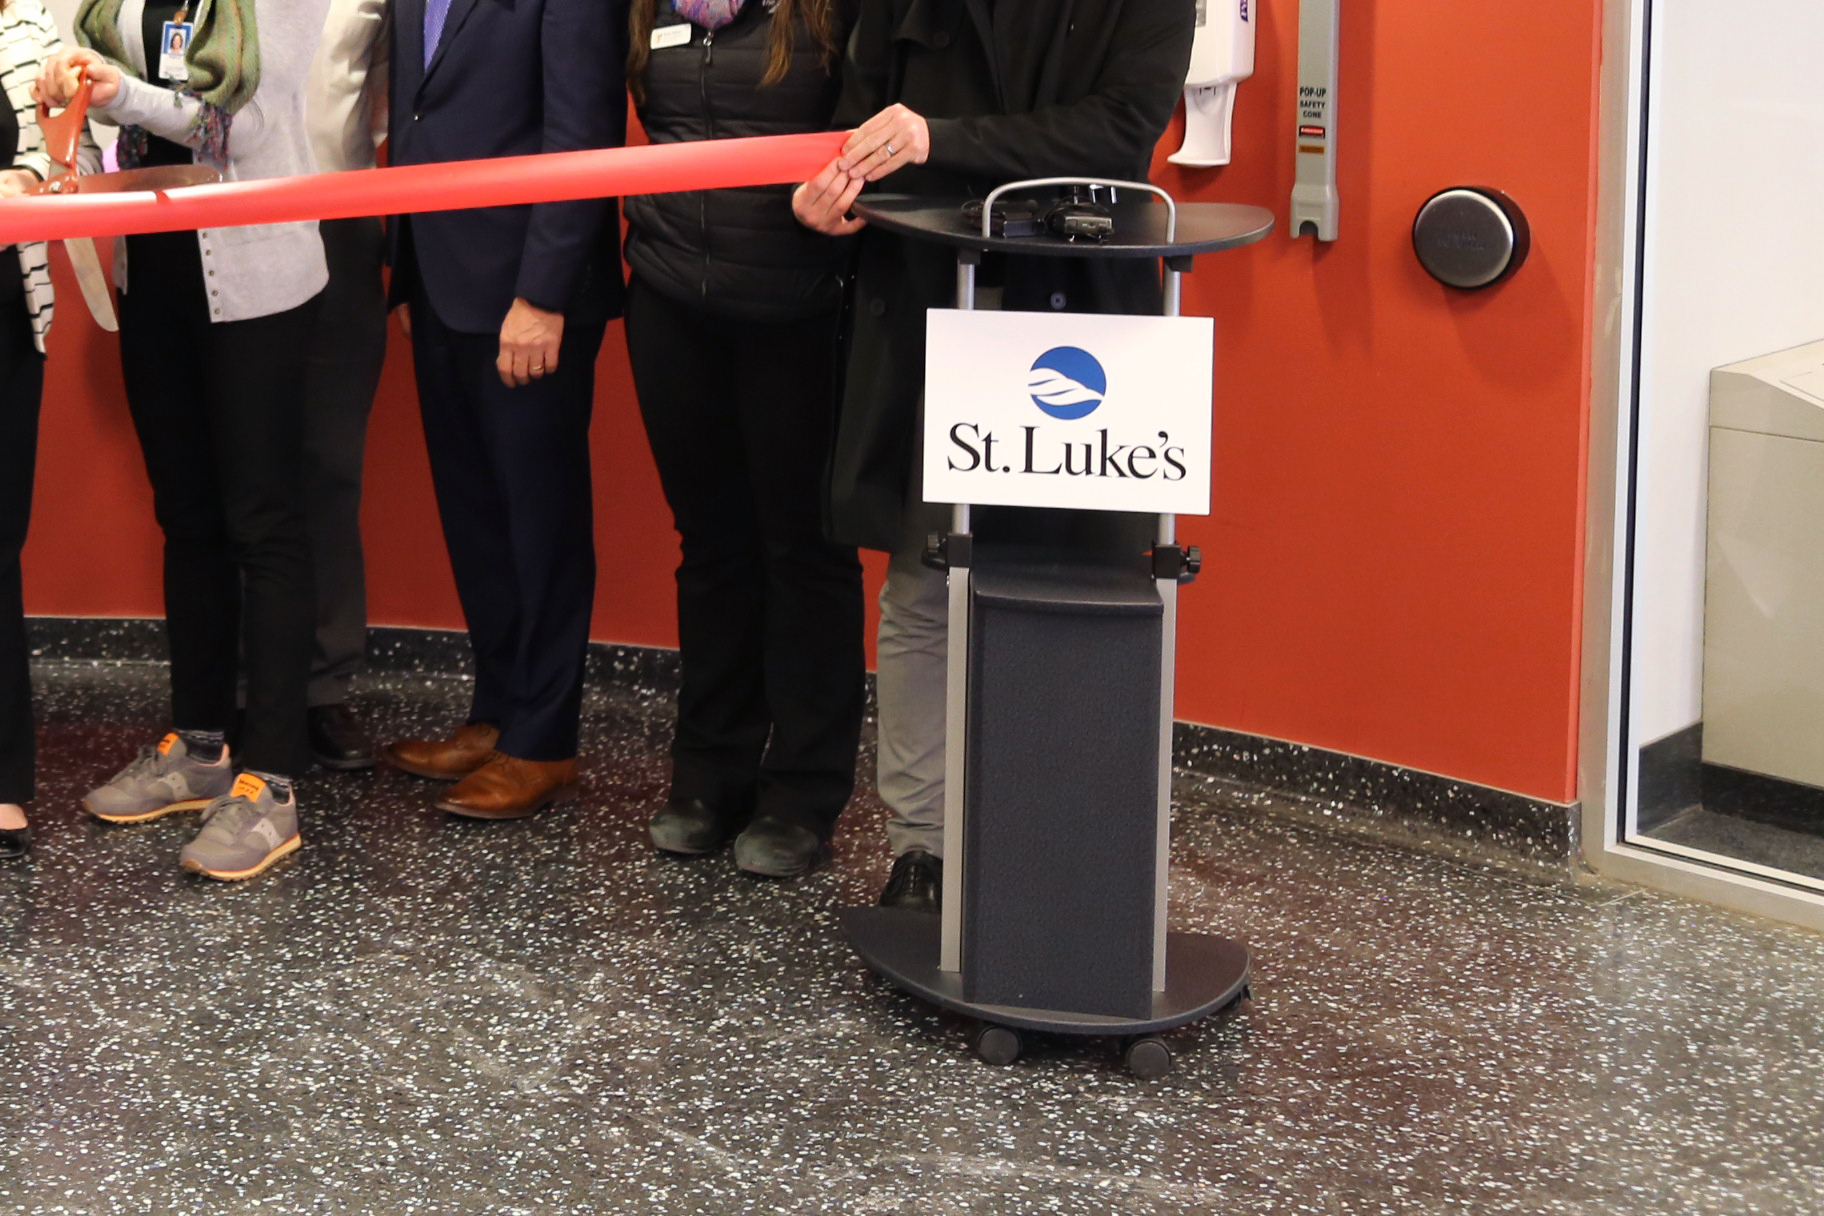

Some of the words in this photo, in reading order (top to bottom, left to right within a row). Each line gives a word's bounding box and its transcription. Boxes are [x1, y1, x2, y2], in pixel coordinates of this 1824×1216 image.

[1299, 86, 1327, 98] POP-UP
[1299, 100, 1325, 109] SAFETY
[947, 422, 1011, 474] St.
[1019, 424, 1187, 482] Luke's
